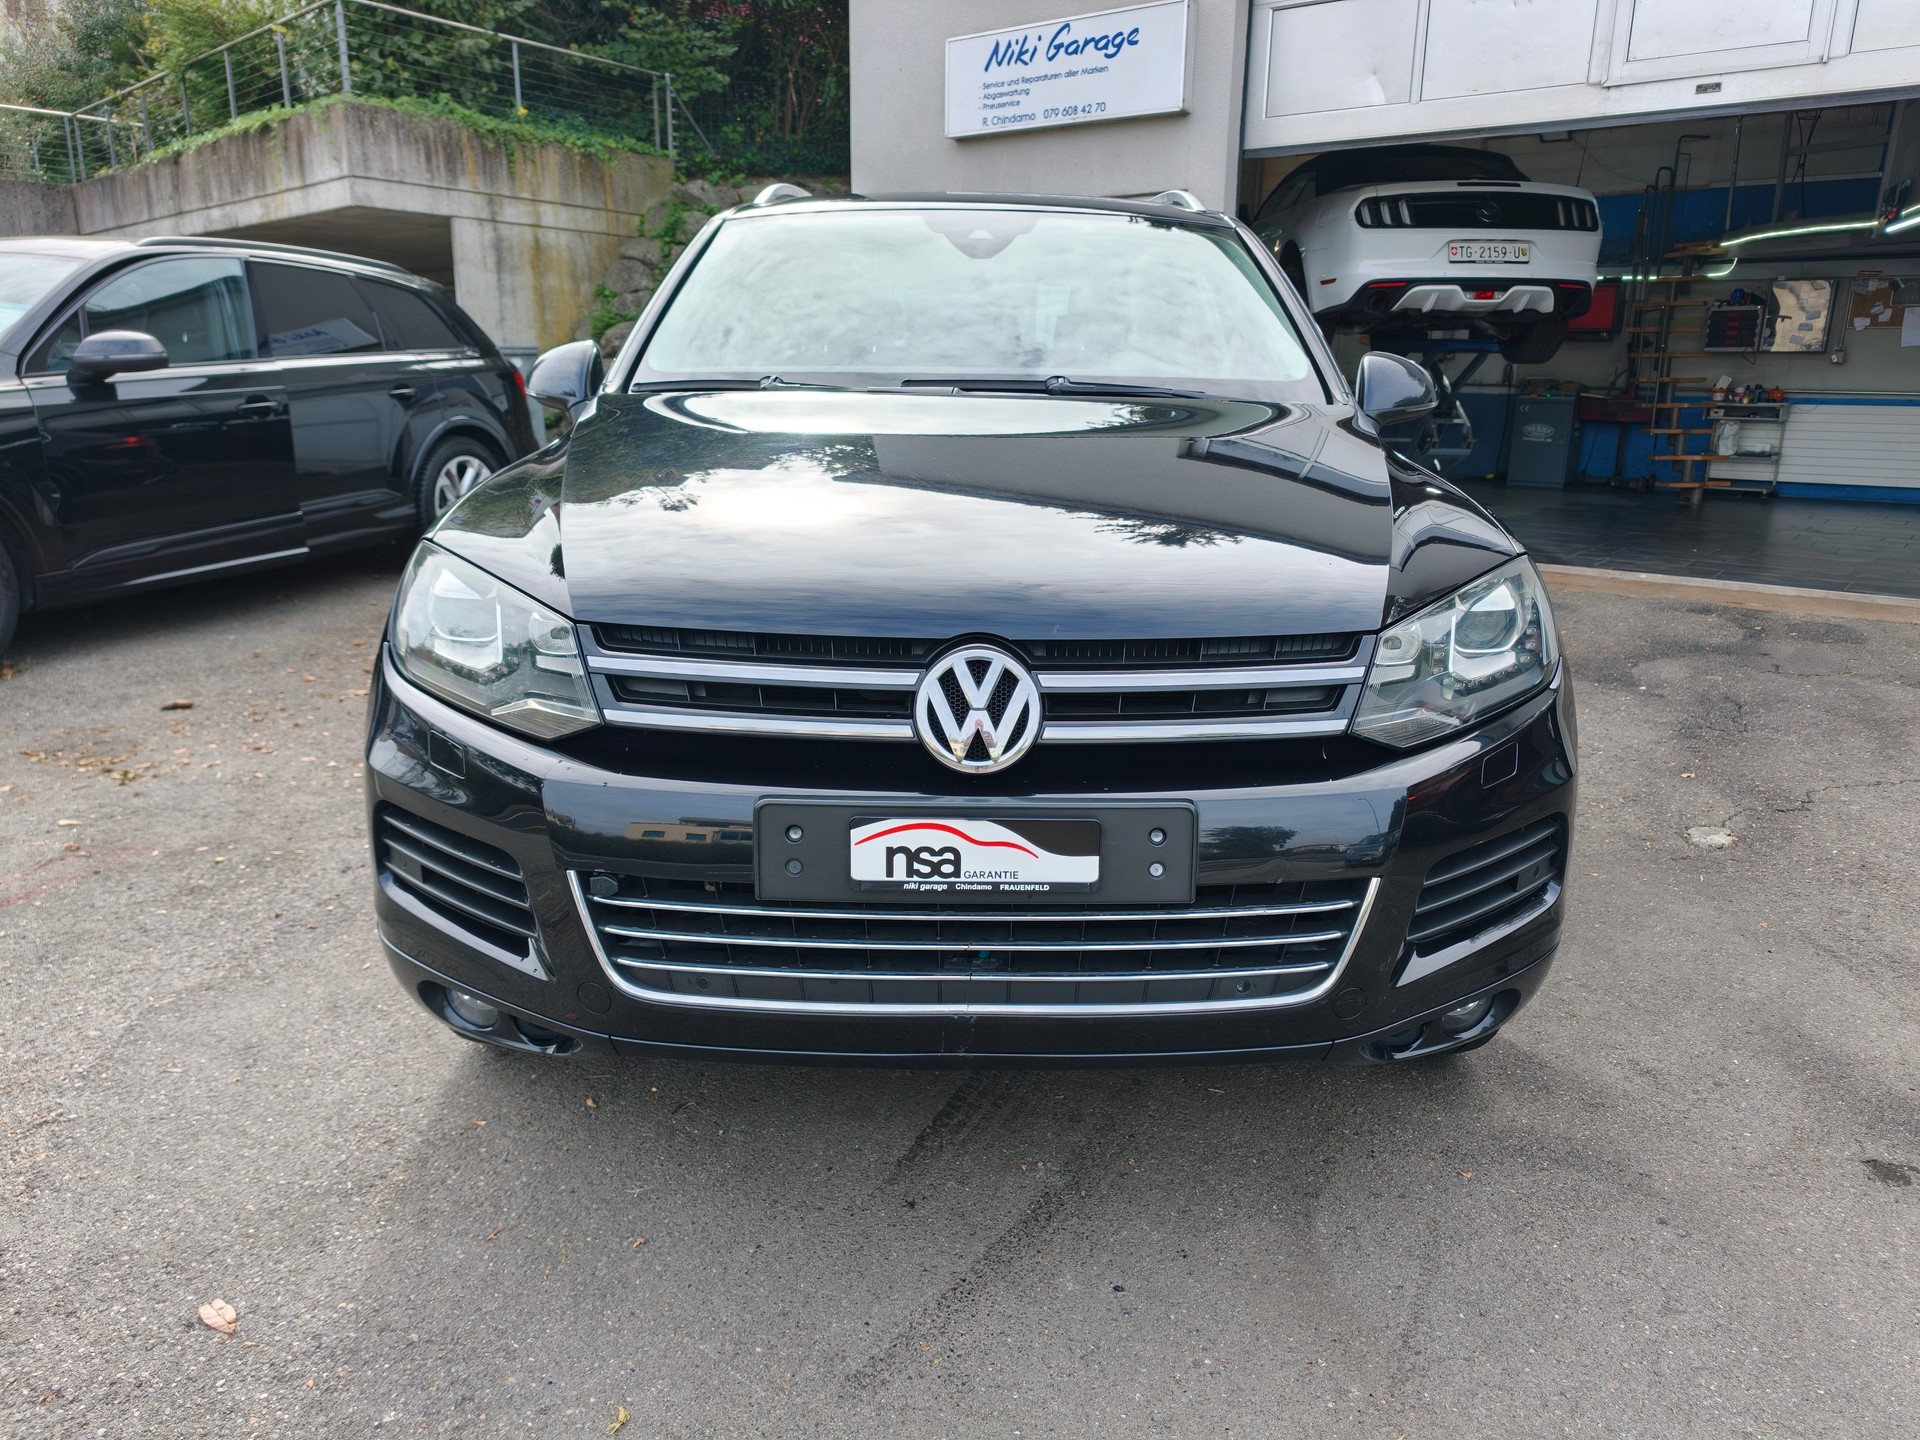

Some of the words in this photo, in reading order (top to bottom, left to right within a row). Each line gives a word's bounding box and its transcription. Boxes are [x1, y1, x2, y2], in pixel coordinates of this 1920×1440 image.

[984, 34, 1042, 73] Niki
[1046, 22, 1140, 62] Garage
[982, 81, 1005, 90] Service
[1007, 78, 1020, 87] und
[1021, 72, 1063, 85] Reparaturen
[1064, 69, 1080, 79] aller
[1080, 65, 1109, 76] Marken
[982, 87, 1030, 101] Abgaswartung
[982, 99, 1021, 111] Pneuservice
[991, 112, 1037, 126] Chindamo
[1043, 107, 1060, 119] 079
[1061, 105, 1078, 117] 608
[1080, 103, 1092, 114] 42
[1094, 101, 1107, 112] 70
[885, 845, 962, 880] nsa
[963, 870, 1020, 880] GARANTIE
[903, 882, 919, 890] niki
[919, 883, 948, 892] garage
[955, 882, 993, 891] Chindamo
[999, 883, 1050, 891] FRAUENFELD
